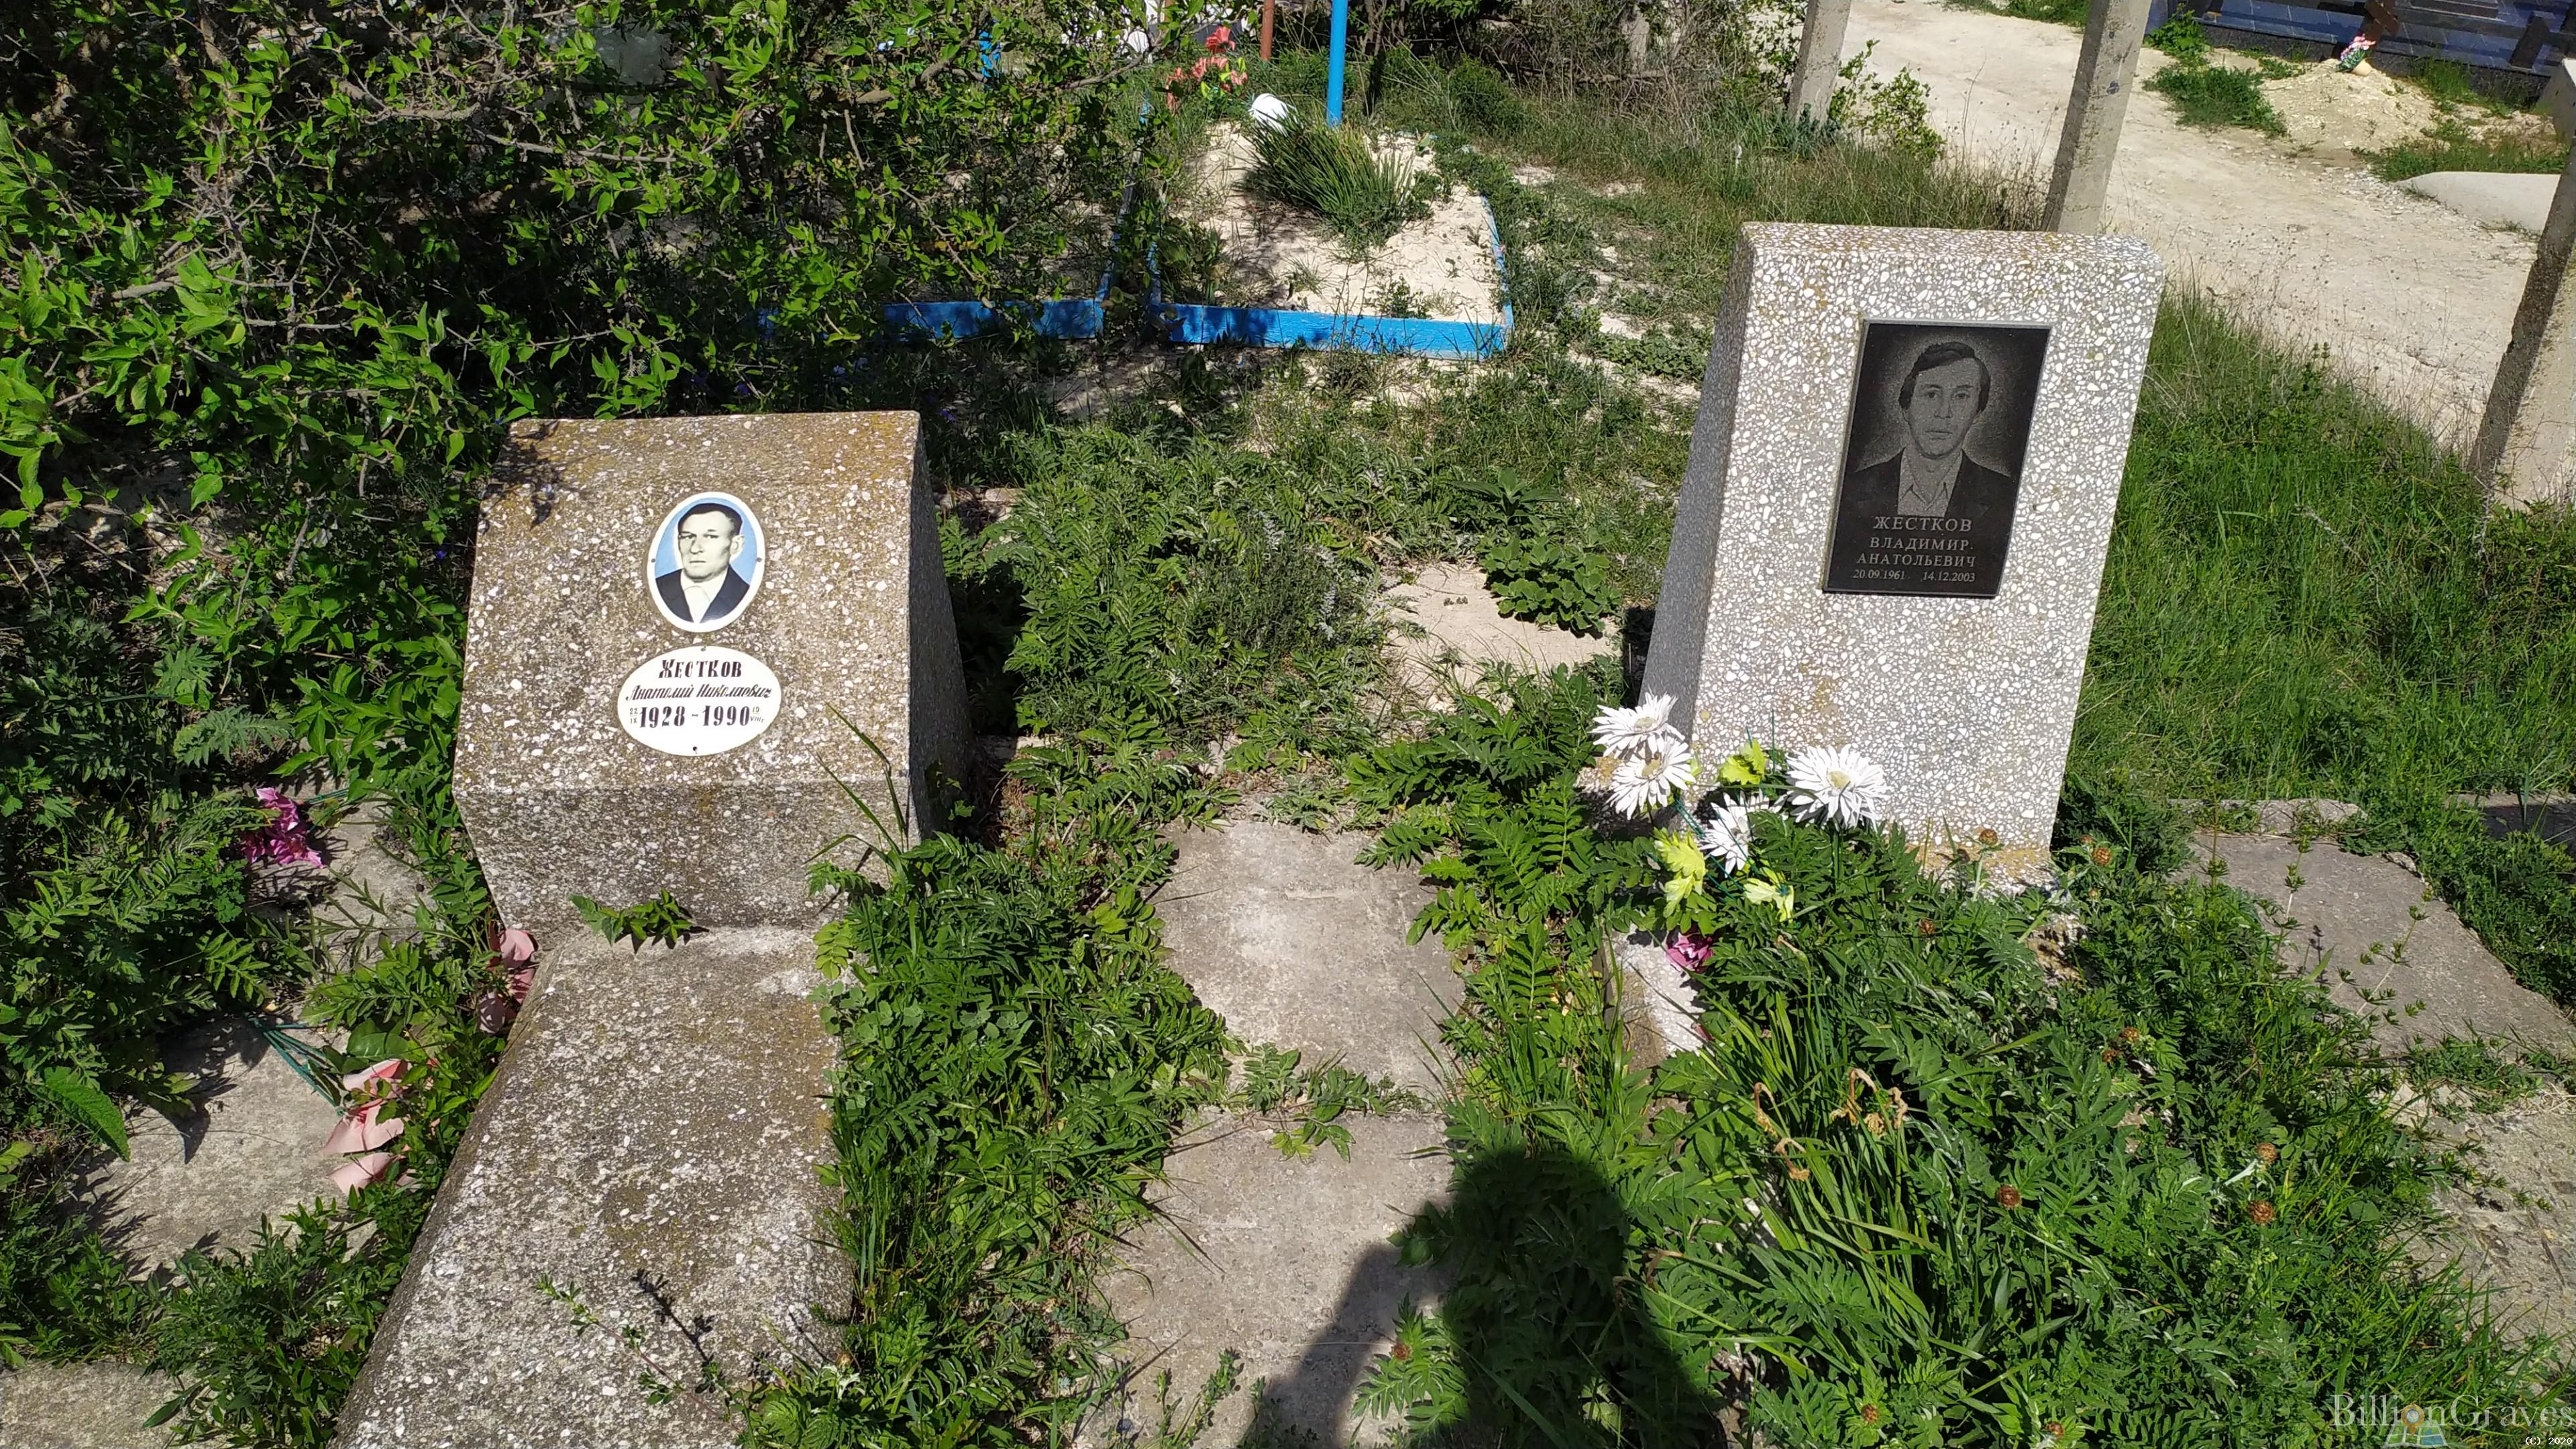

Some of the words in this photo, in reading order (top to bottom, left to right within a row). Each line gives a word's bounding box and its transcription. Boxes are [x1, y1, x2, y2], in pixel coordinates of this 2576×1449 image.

[1872, 516, 1972, 533] ЖЕСТКОВ
[1856, 553, 1976, 568] АНАТОЛЬЕВИЧ
[1852, 569, 1906, 580] 20.09.1961
[1922, 572, 1976, 582] 14.12.2003
[658, 659, 742, 679] ЖЕСТКОВ
[625, 684, 695, 701] Анатолий
[695, 684, 772, 699] Николаевич
[639, 705, 686, 729] 1928
[702, 705, 750, 727] 1990
